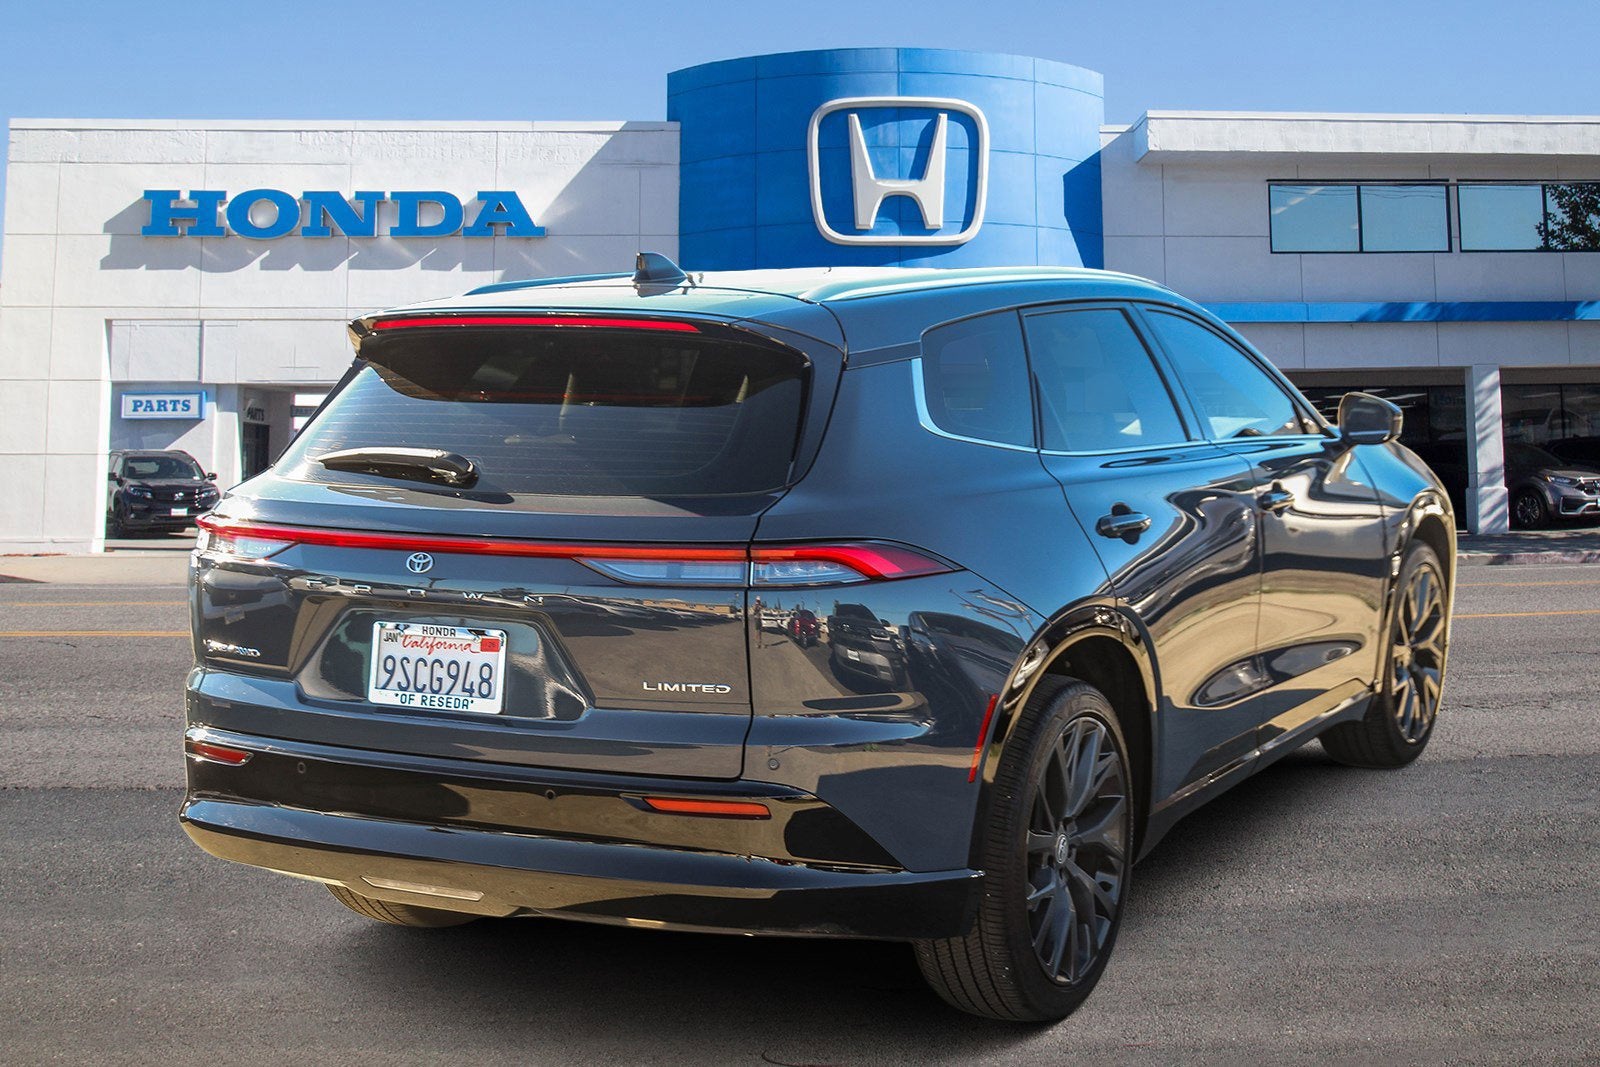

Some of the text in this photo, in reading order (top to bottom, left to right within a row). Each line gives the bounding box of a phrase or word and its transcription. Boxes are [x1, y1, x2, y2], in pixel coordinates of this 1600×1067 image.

[141, 189, 547, 239] HONDA
[132, 399, 191, 412] PARTS
[383, 632, 398, 643] JAN
[422, 625, 456, 636] HONDA
[400, 634, 480, 655] California
[381, 655, 493, 699] 9SCG948
[642, 681, 732, 694] LIMITED
[400, 693, 470, 709] OF RESEDA
